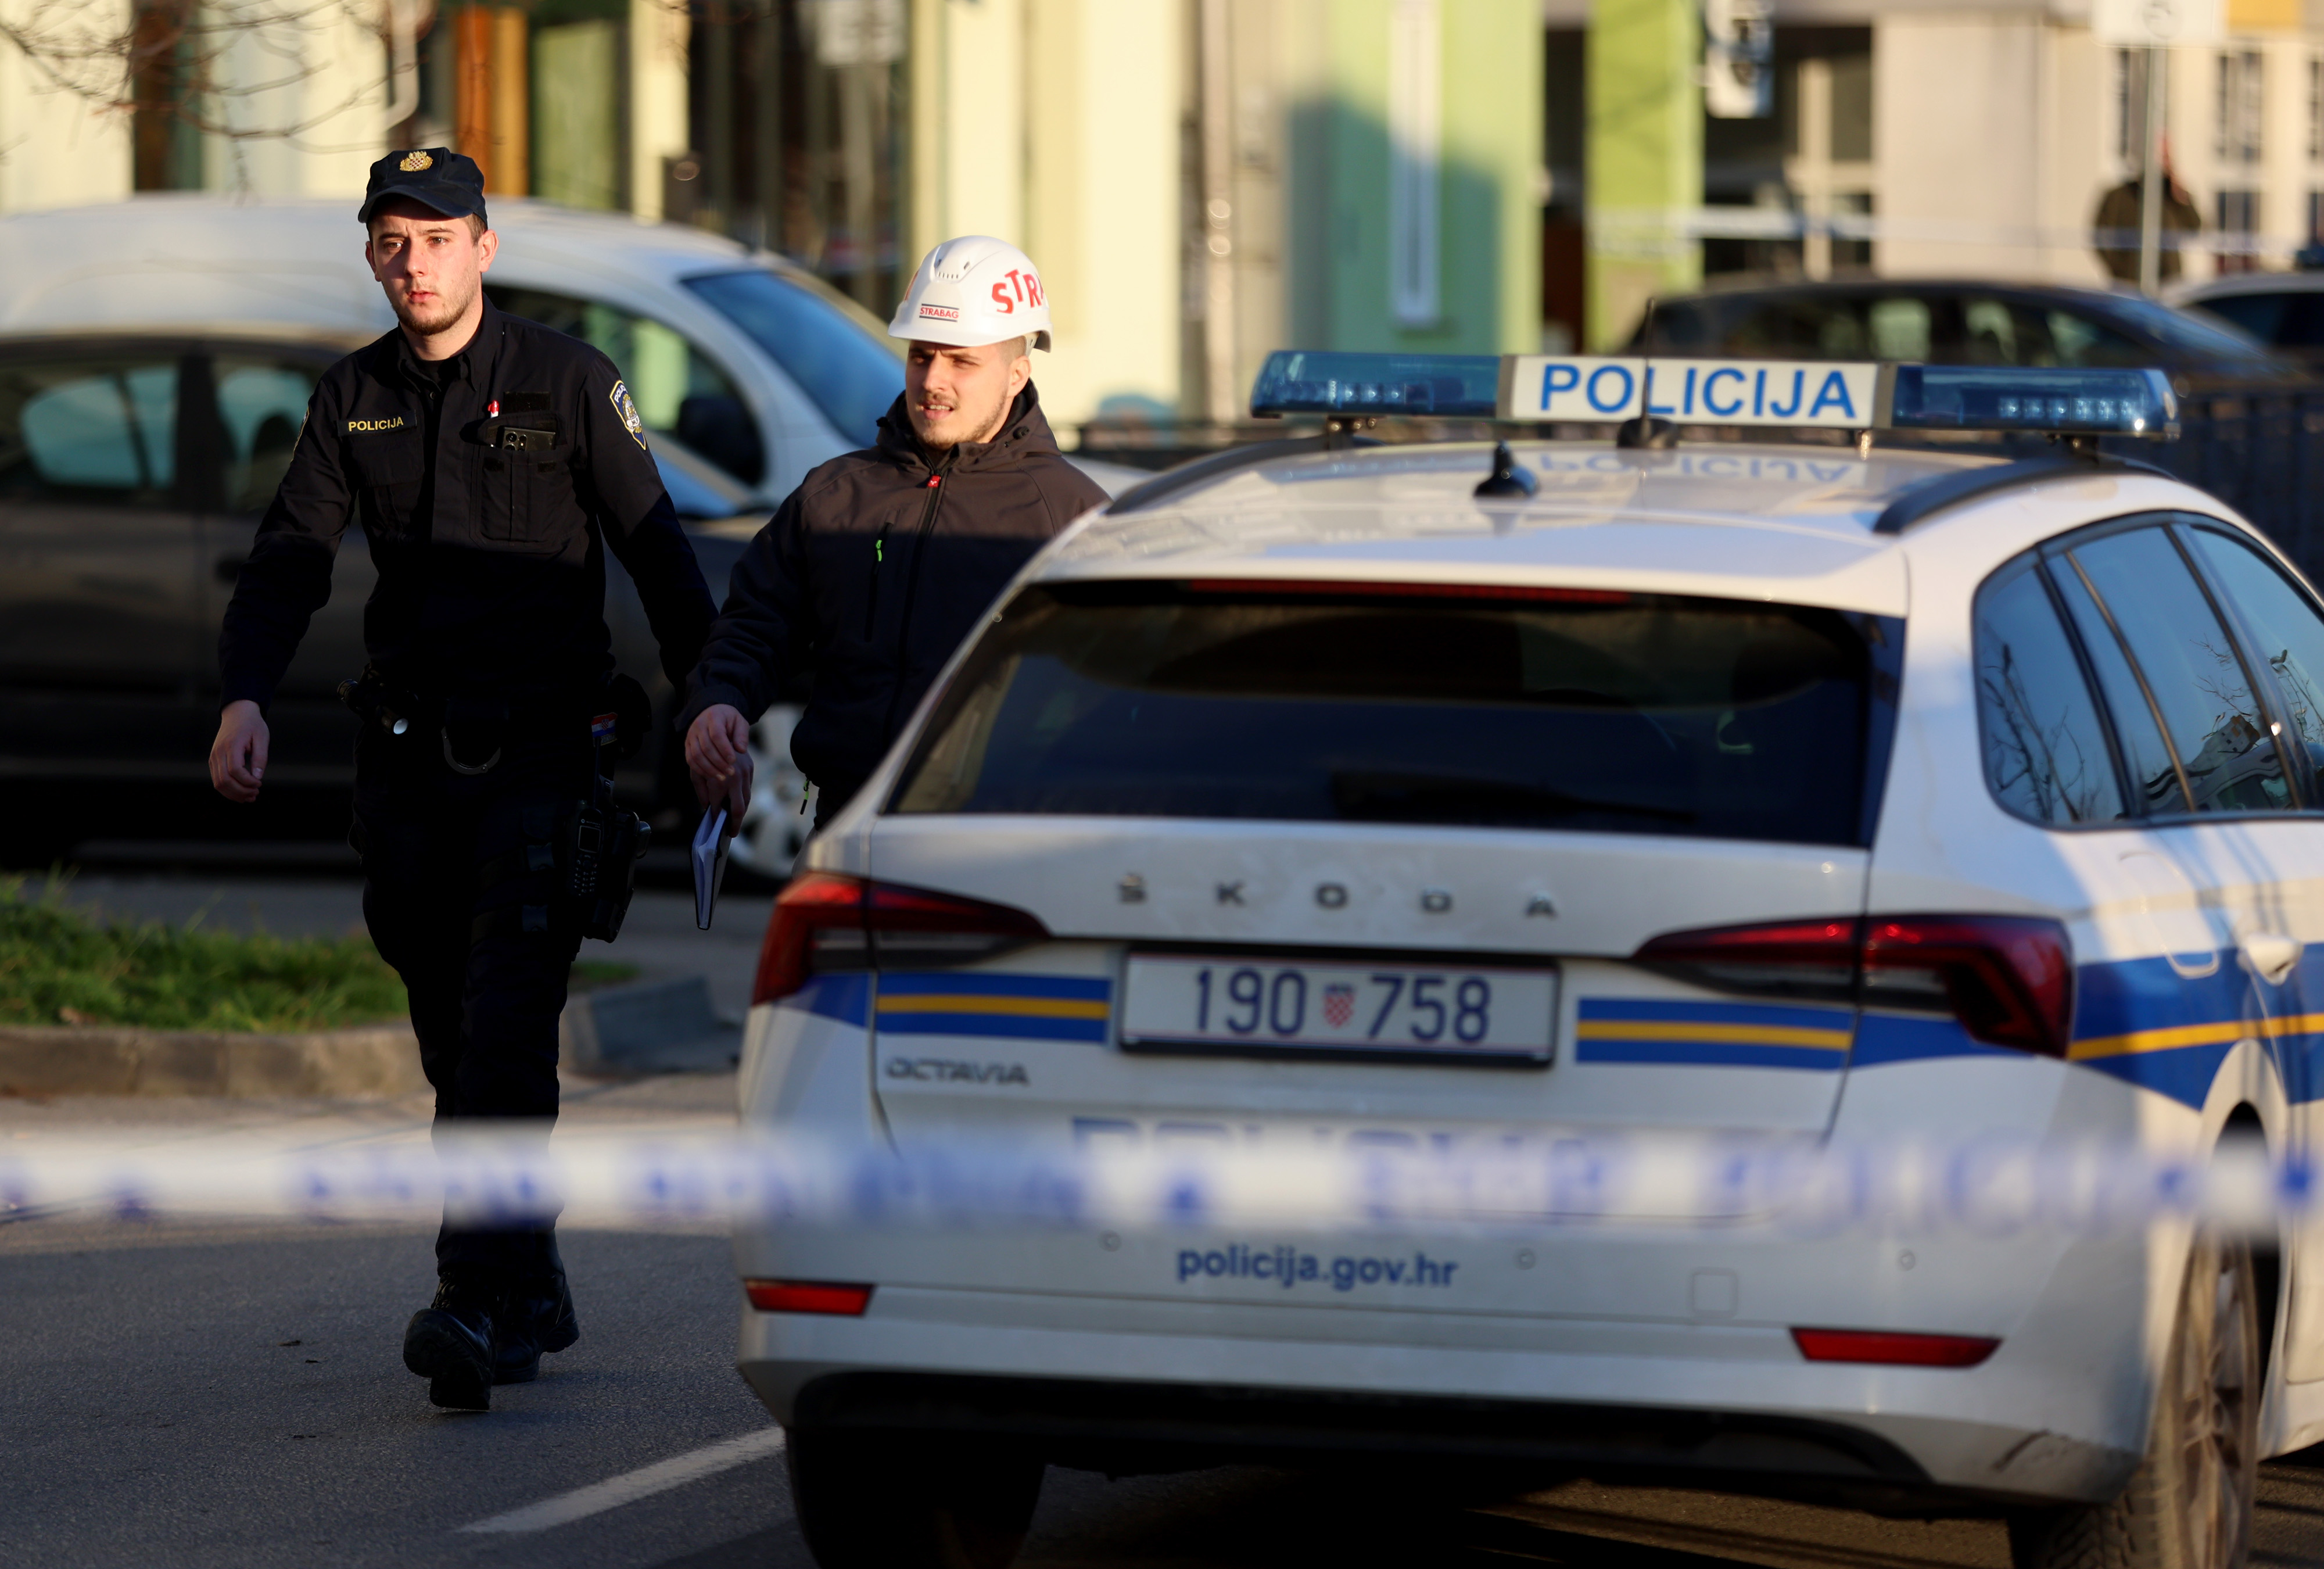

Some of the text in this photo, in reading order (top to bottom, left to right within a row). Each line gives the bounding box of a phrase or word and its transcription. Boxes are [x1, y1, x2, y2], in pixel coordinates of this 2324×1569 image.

[920, 306, 959, 319] STRABAG
[1540, 363, 1857, 419] POLICIJA
[349, 416, 404, 432] POLICIJA
[1196, 967, 1491, 1044] 190 758
[886, 1056, 1031, 1087] OCTAVIA
[1177, 1244, 1459, 1292] policija.gov.hr
